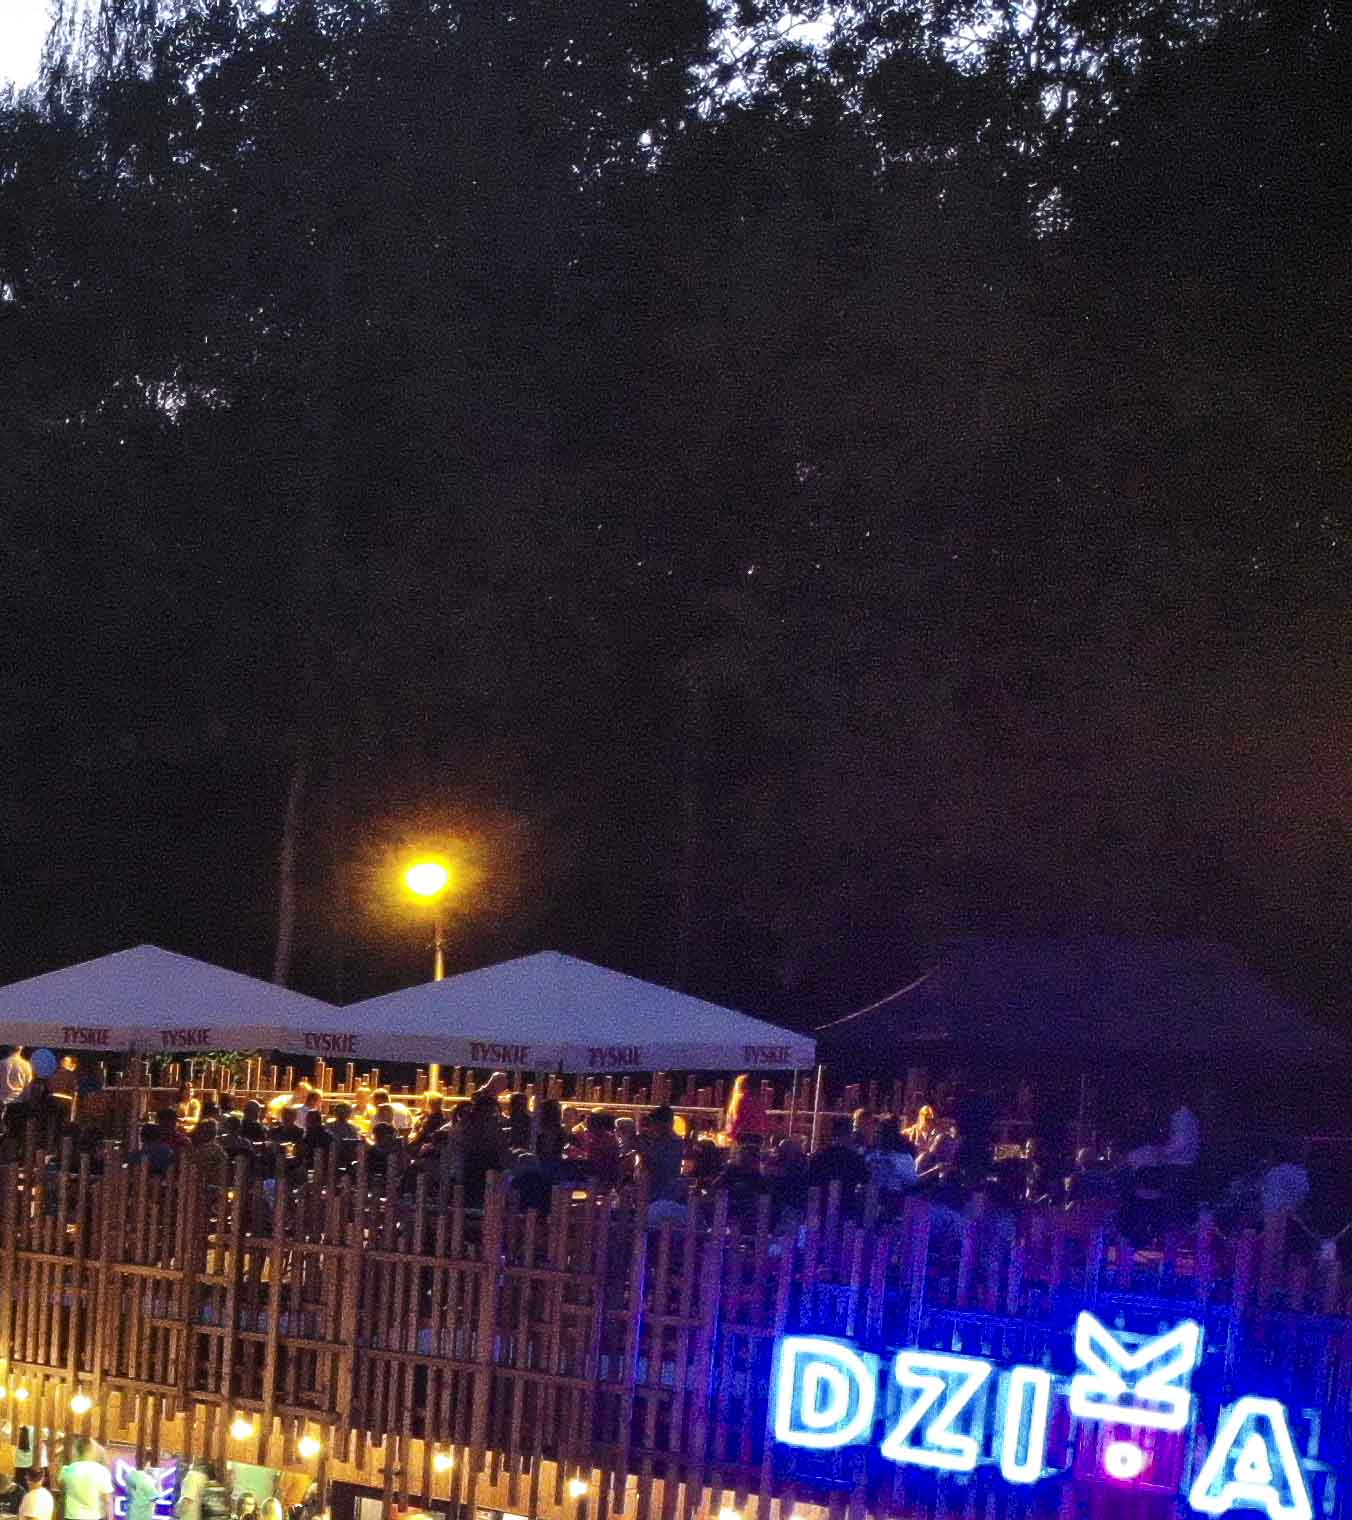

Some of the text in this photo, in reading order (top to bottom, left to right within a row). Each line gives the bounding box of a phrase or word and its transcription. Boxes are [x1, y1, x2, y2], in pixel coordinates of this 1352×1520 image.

[62, 1028, 110, 1045] TYSKIE
[160, 1029, 210, 1046] TYSKIE
[303, 1032, 360, 1053] TYSKIE
[470, 1042, 531, 1063] TYSKIE
[589, 1046, 642, 1066] TYSKIE
[743, 1045, 792, 1064] TYSKIE
